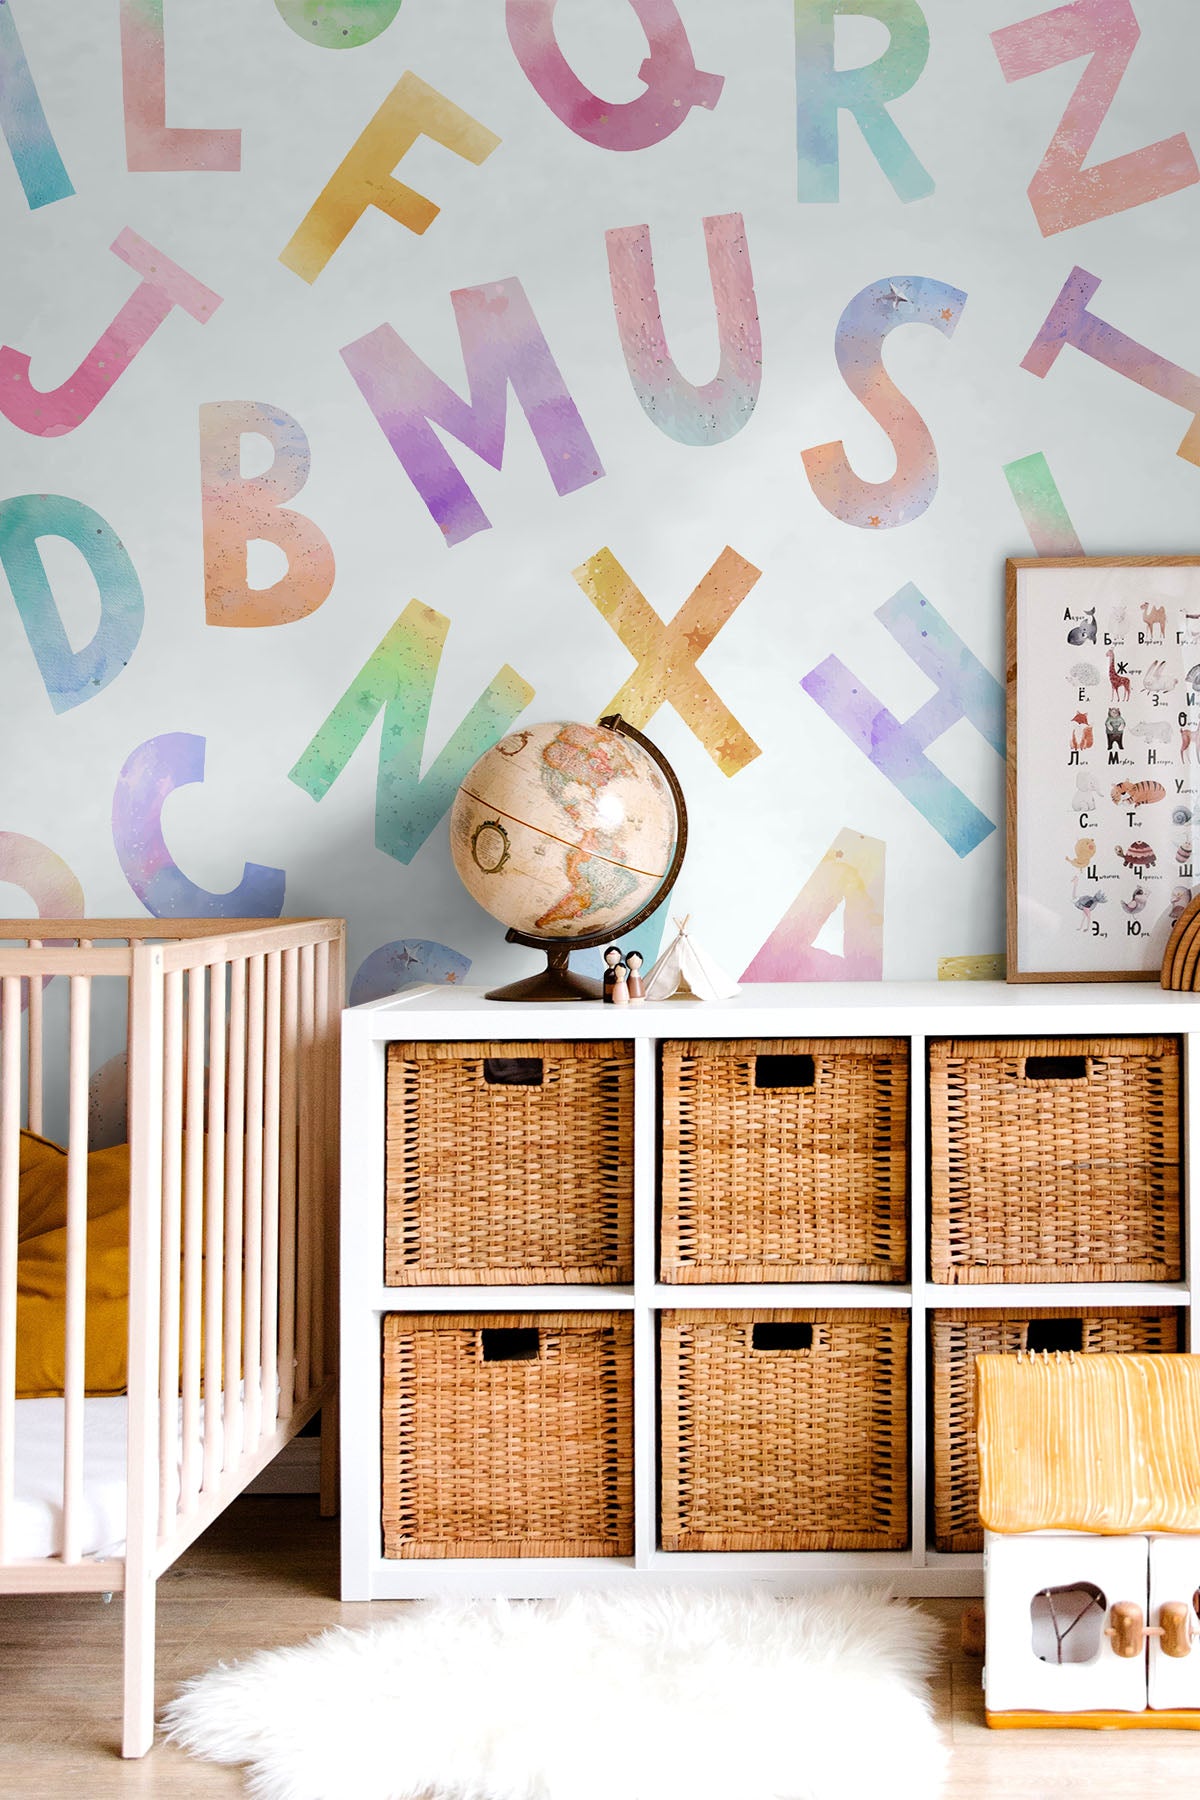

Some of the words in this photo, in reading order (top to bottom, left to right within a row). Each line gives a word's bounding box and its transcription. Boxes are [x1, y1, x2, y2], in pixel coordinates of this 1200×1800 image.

[278, 70, 502, 285] F
[505, 0, 725, 151] Q
[794, 0, 936, 203] R
[990, 0, 1200, 238] Z
[0, 226, 224, 438] J
[339, 276, 605, 547] M
[604, 212, 763, 447] U
[801, 275, 968, 530] S
[0, 493, 145, 715] D
[200, 400, 336, 628] B
[287, 597, 536, 865] N
[572, 545, 763, 776] X
[800, 581, 1008, 859] H
[111, 731, 286, 918] C
[738, 827, 886, 983] A
